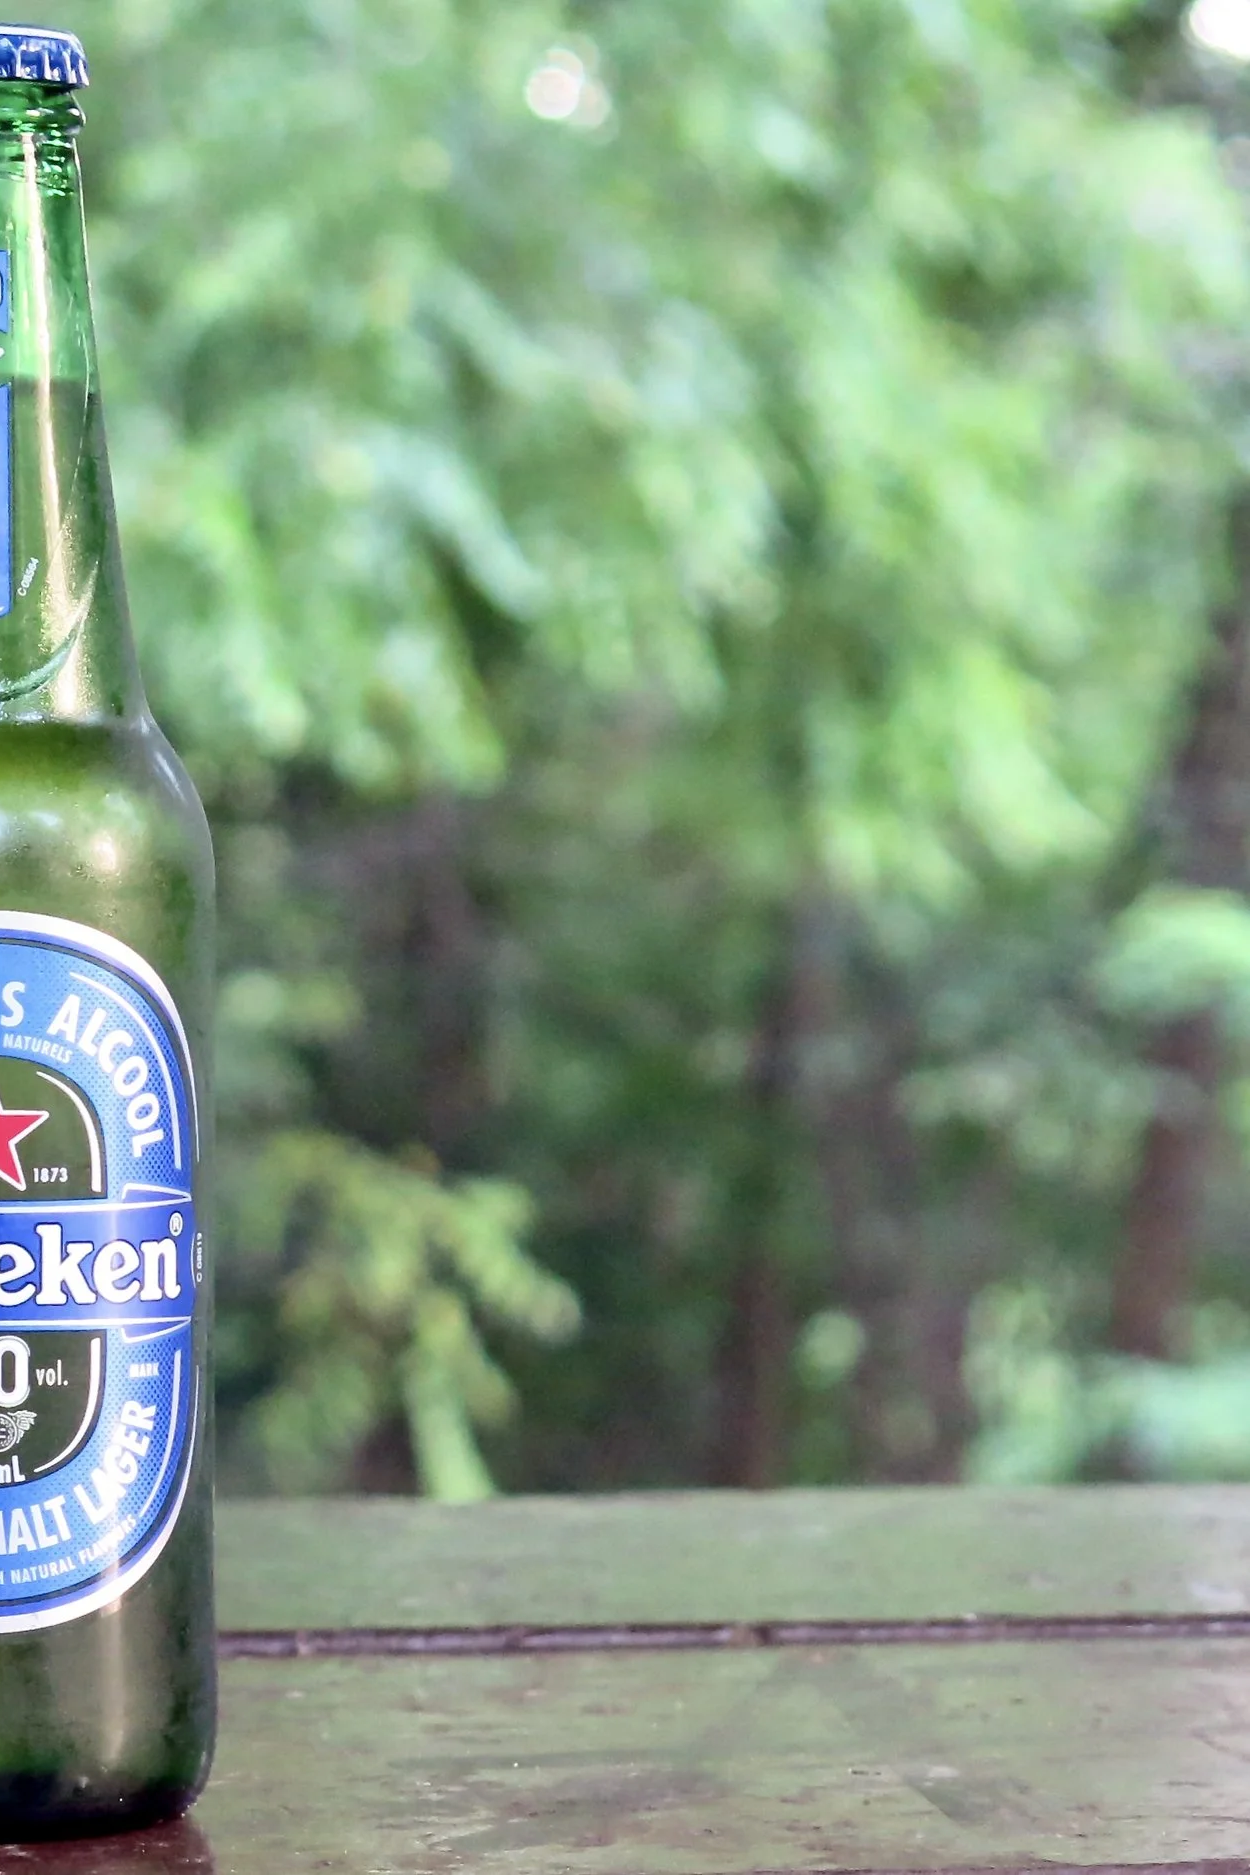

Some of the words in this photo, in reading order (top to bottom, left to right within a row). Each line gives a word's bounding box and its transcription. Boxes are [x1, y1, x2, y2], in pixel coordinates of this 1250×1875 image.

[2, 1034, 73, 1065] NATURELS
[46, 994, 165, 1158] ALCOOL
[32, 1166, 69, 1183] 1873
[35, 1358, 69, 1387] vol.
[129, 1362, 160, 1378] MARK
[72, 1400, 157, 1526] LAGER
[10, 1557, 76, 1584] NATURAL
